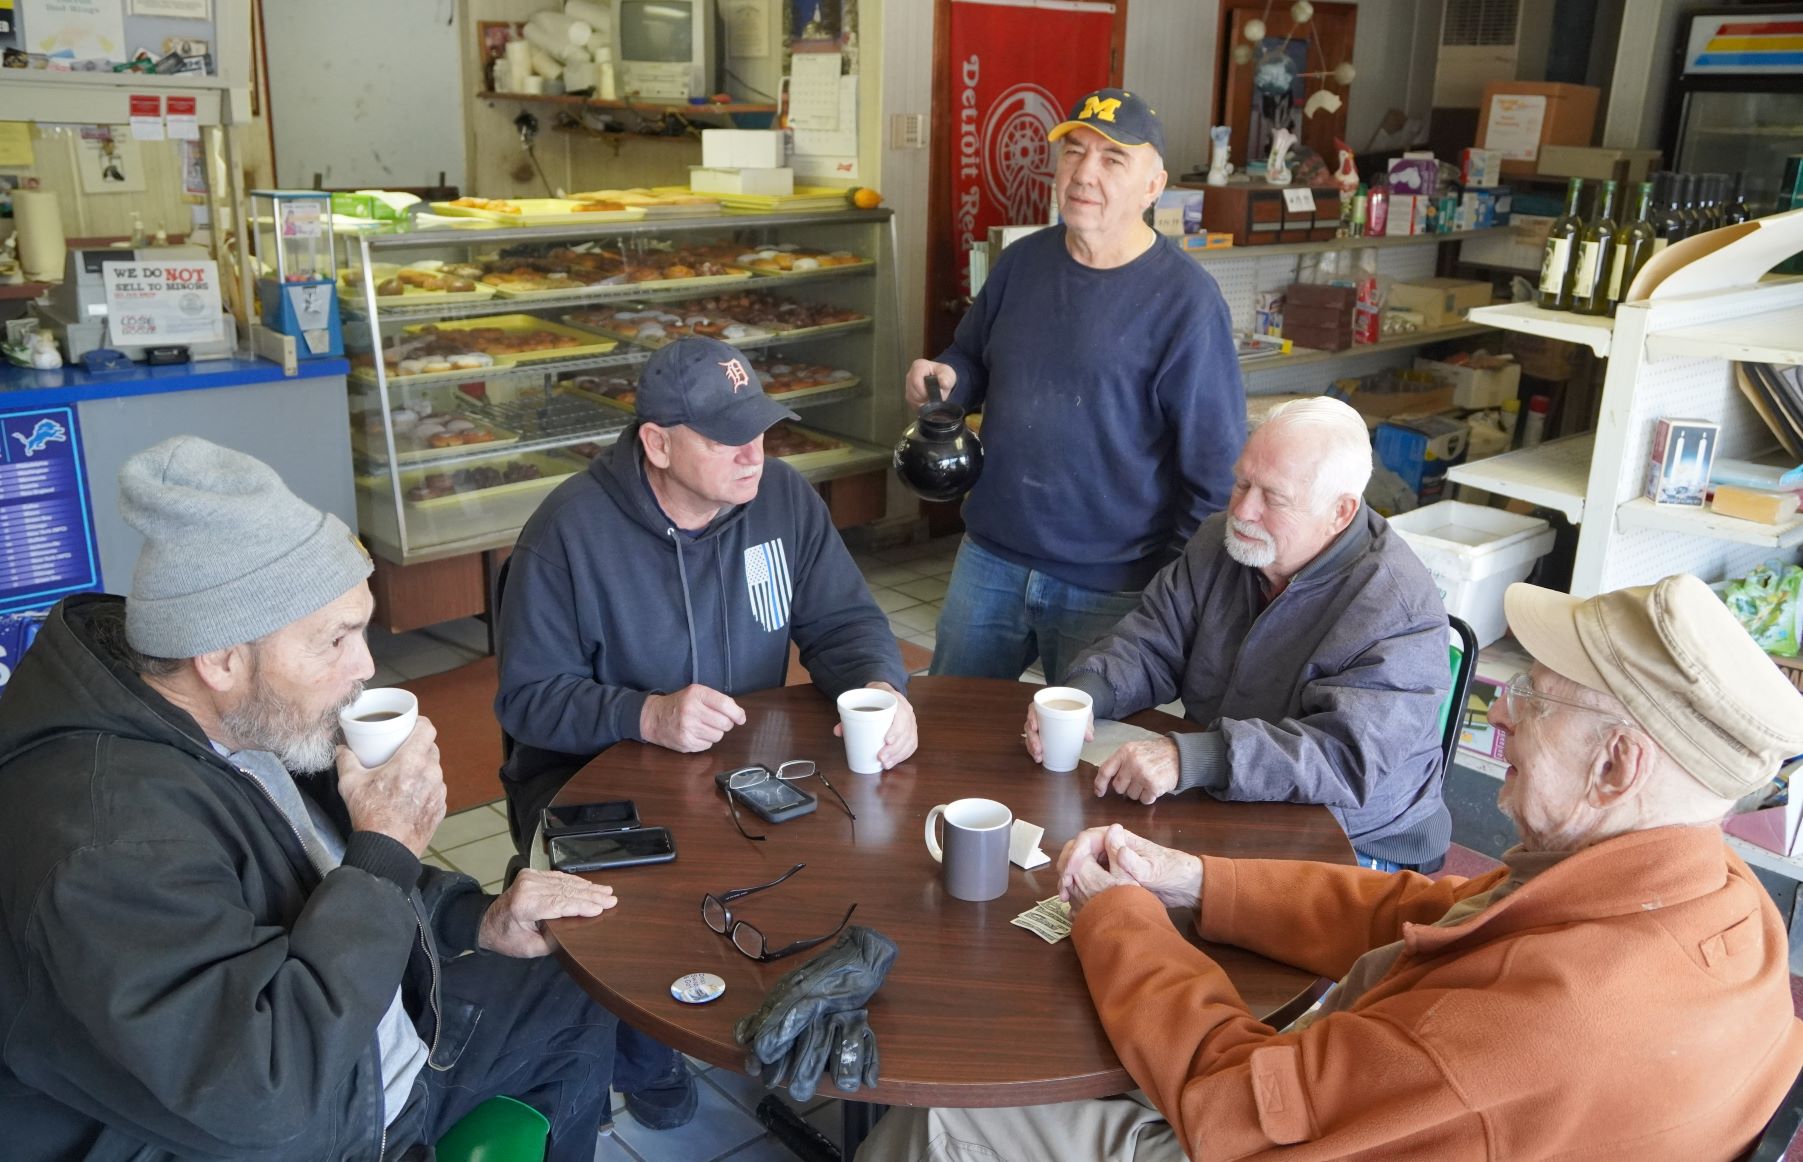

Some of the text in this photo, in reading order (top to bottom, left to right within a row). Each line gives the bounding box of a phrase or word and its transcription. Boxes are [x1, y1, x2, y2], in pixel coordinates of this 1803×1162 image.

[961, 54, 980, 179] Detroit
[1078, 95, 1121, 122] M
[114, 268, 204, 282] WE DO NOT
[115, 282, 209, 291] SELL TO MINORS
[717, 358, 749, 394] D
